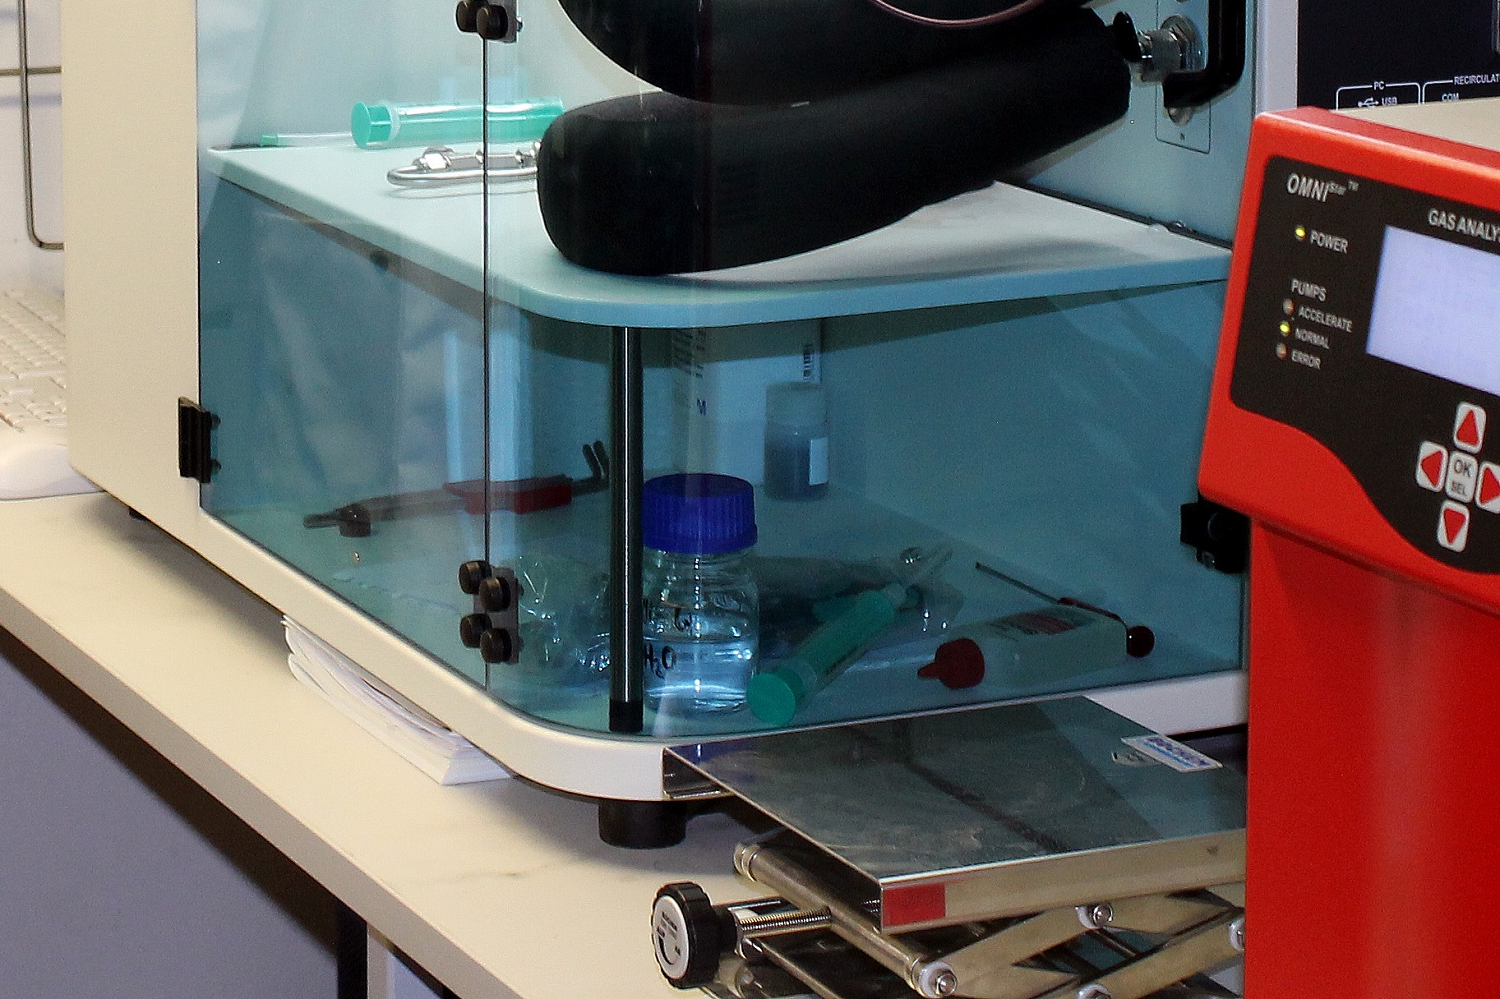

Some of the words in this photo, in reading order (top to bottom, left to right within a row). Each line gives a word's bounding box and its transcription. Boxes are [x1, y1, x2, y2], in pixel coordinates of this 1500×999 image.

[1373, 81, 1385, 91] PC
[1428, 209, 1457, 231] GAS
[1310, 229, 1349, 255] POWER
[1291, 278, 1327, 302] PUMPS
[1299, 305, 1353, 334] ACCELERATE
[1295, 327, 1330, 350] NORMAL
[1291, 349, 1321, 371] ERROR
[1454, 459, 1473, 479] OK
